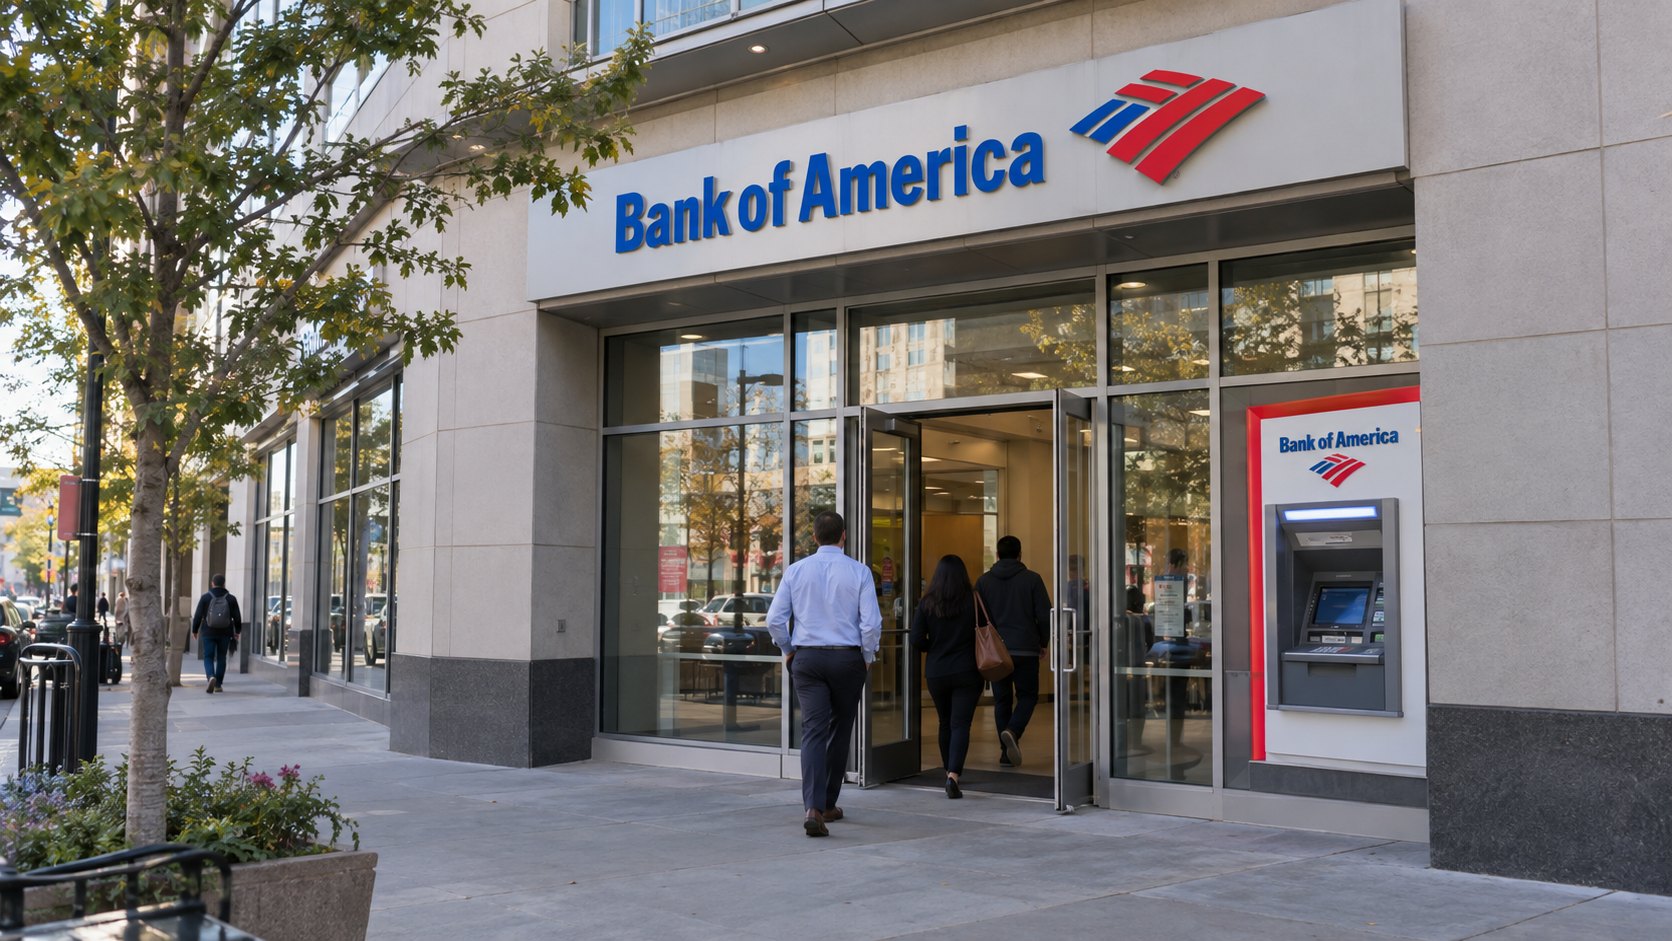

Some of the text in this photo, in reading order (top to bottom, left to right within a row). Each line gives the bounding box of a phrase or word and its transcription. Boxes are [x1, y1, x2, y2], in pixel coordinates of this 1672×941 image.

[615, 124, 1046, 254] Bank of America
[1279, 427, 1399, 453] Bank of America
